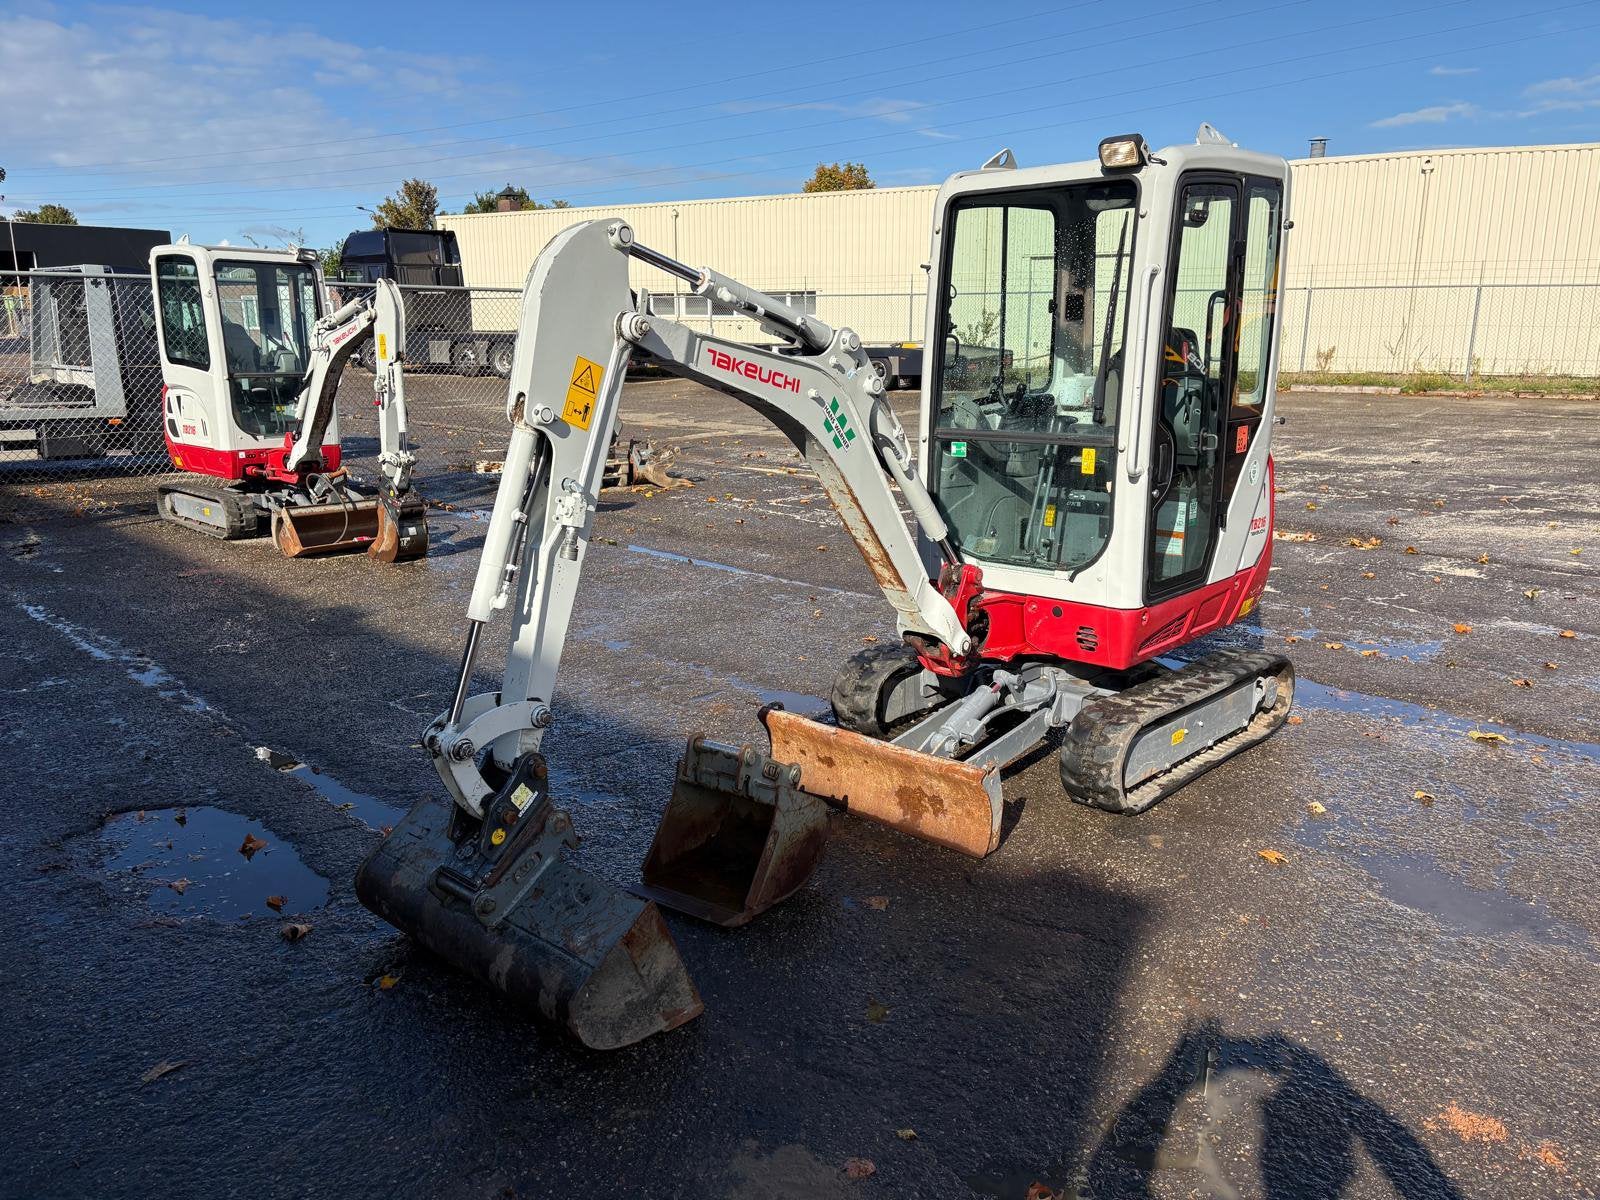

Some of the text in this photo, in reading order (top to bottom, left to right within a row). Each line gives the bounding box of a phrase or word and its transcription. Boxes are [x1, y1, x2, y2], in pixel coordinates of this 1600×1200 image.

[706, 347, 802, 394] TAKEUCHI
[824, 405, 850, 449] HANS WARNER
